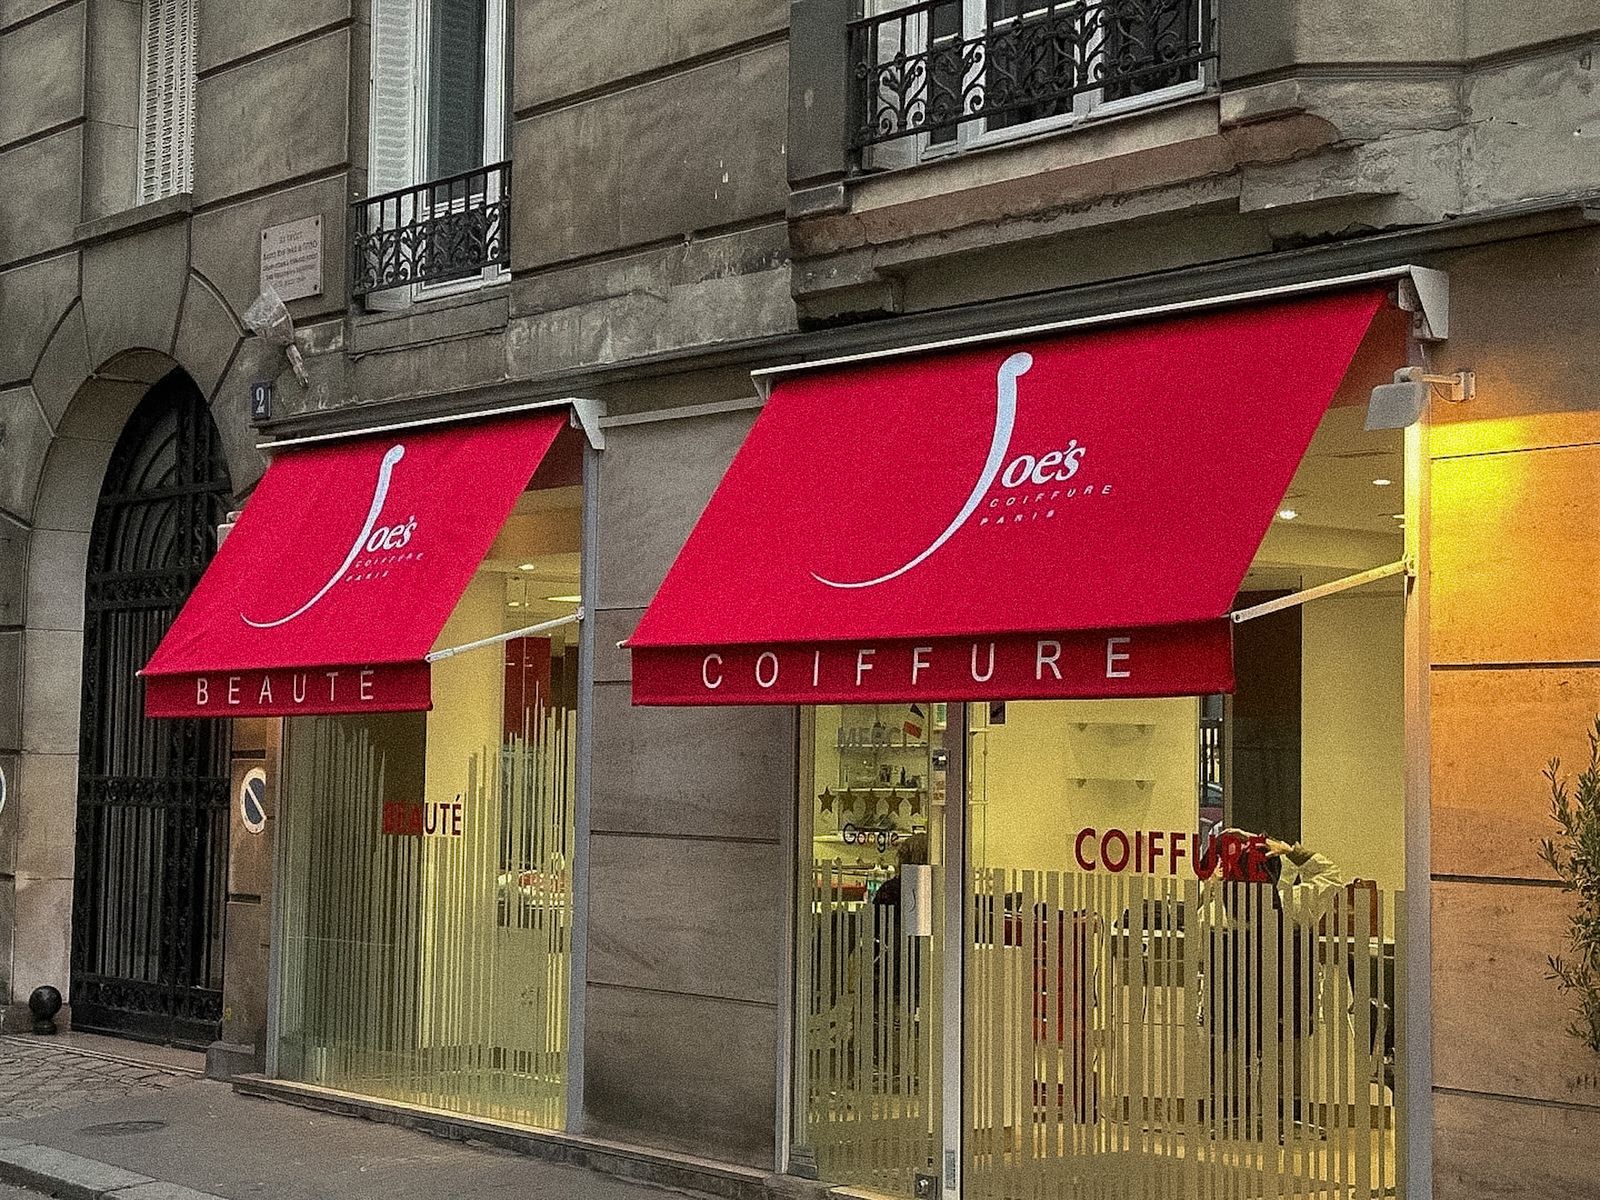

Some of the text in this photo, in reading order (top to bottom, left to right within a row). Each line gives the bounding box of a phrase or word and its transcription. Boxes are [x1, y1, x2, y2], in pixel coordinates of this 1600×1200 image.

[255, 387, 265, 414] 2
[810, 351, 1087, 589] Joe's
[989, 484, 1113, 508] COIFFURE
[240, 444, 418, 628] Joe's
[979, 509, 1055, 526] PARIS
[702, 636, 1131, 689] COIFFURE
[196, 665, 375, 705] BEAUTÉ
[843, 822, 899, 853] Google
[1074, 827, 1269, 883] COIFFURE
